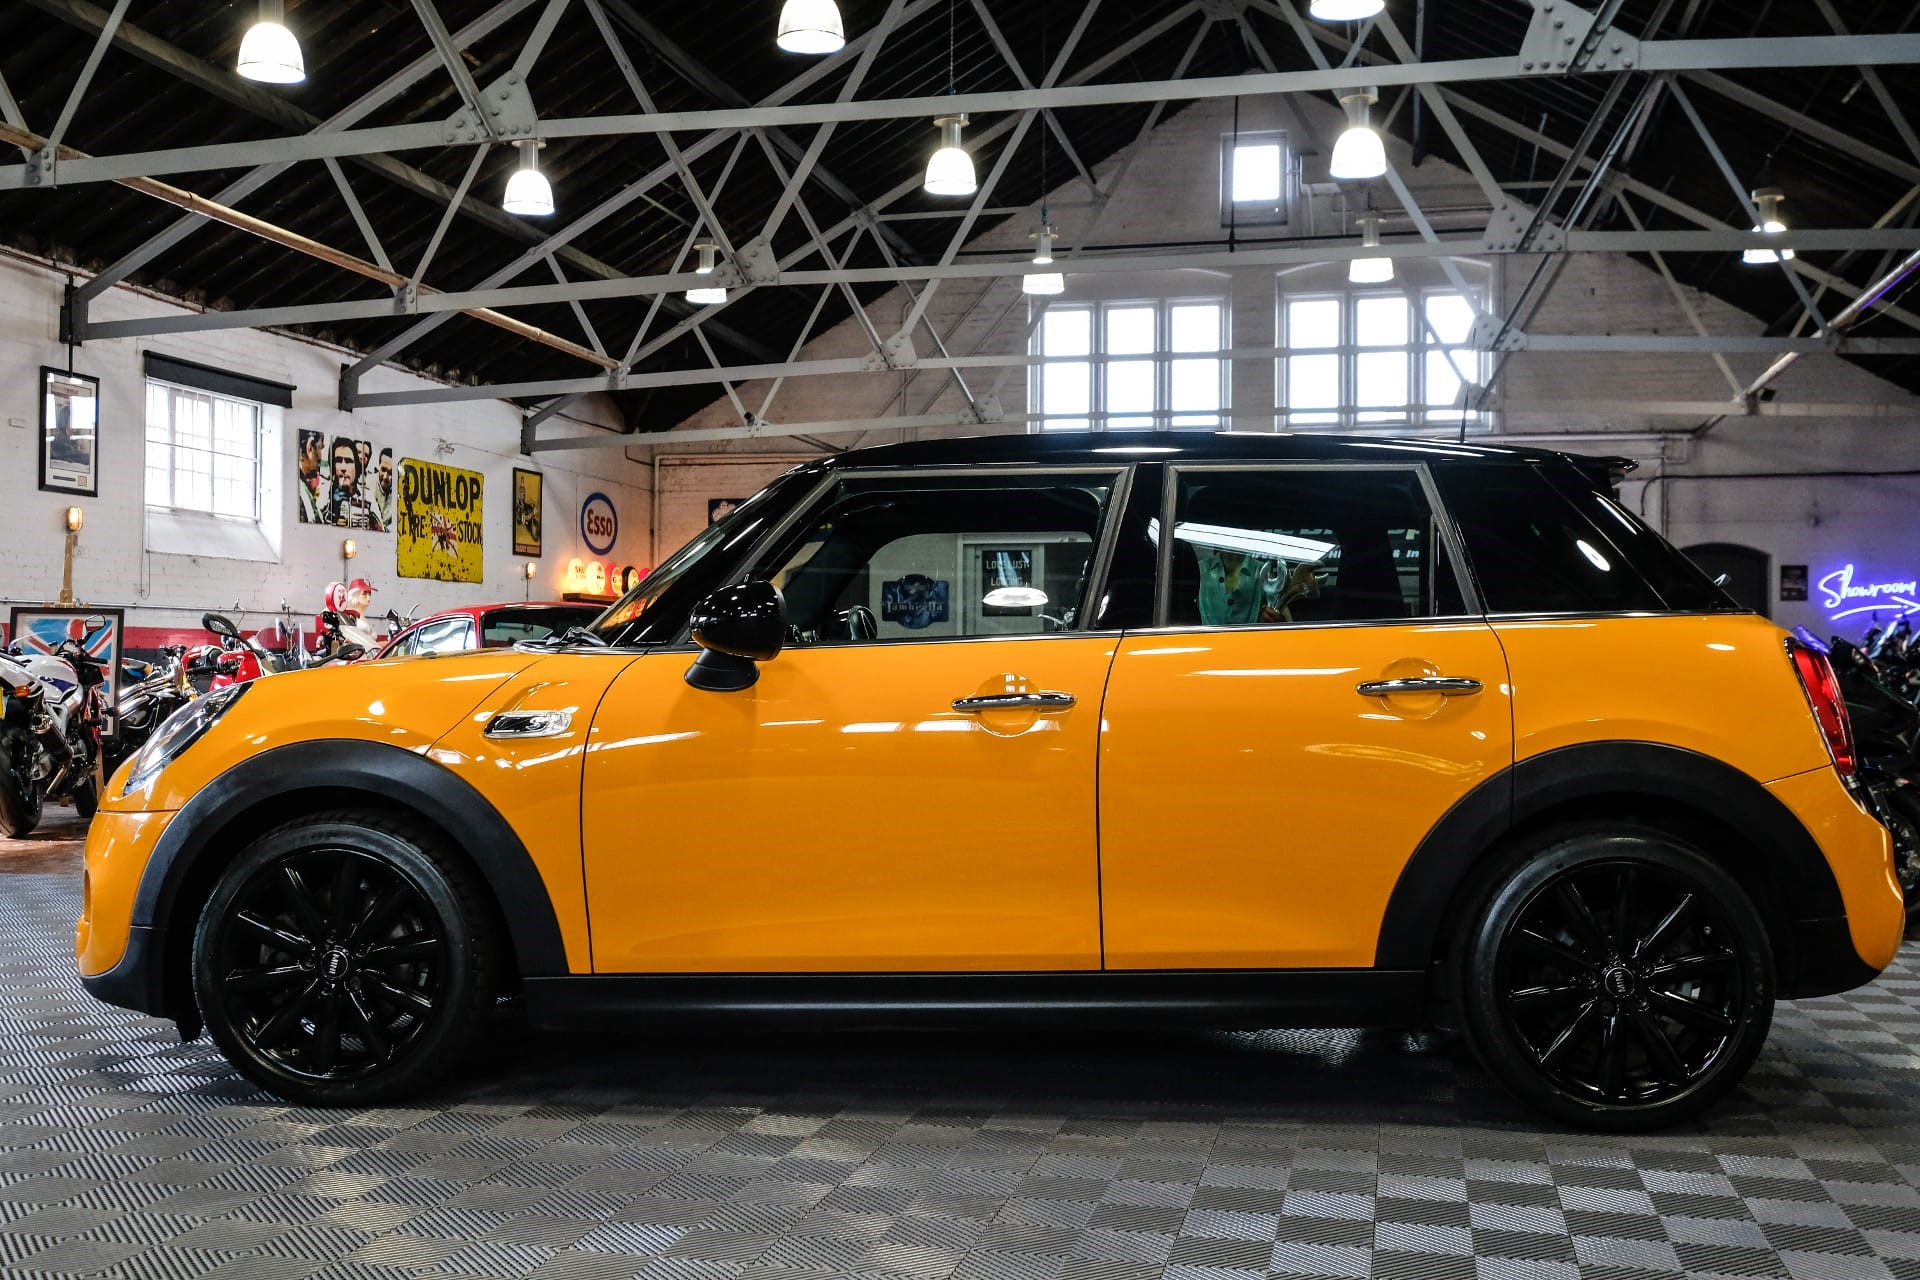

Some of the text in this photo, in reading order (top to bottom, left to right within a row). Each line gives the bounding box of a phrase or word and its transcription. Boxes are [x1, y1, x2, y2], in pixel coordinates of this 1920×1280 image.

[403, 465, 480, 512] DUNLOP
[458, 520, 482, 545] STOCK
[1818, 563, 1917, 608] Showroom
[1614, 972, 1625, 992] MINI
